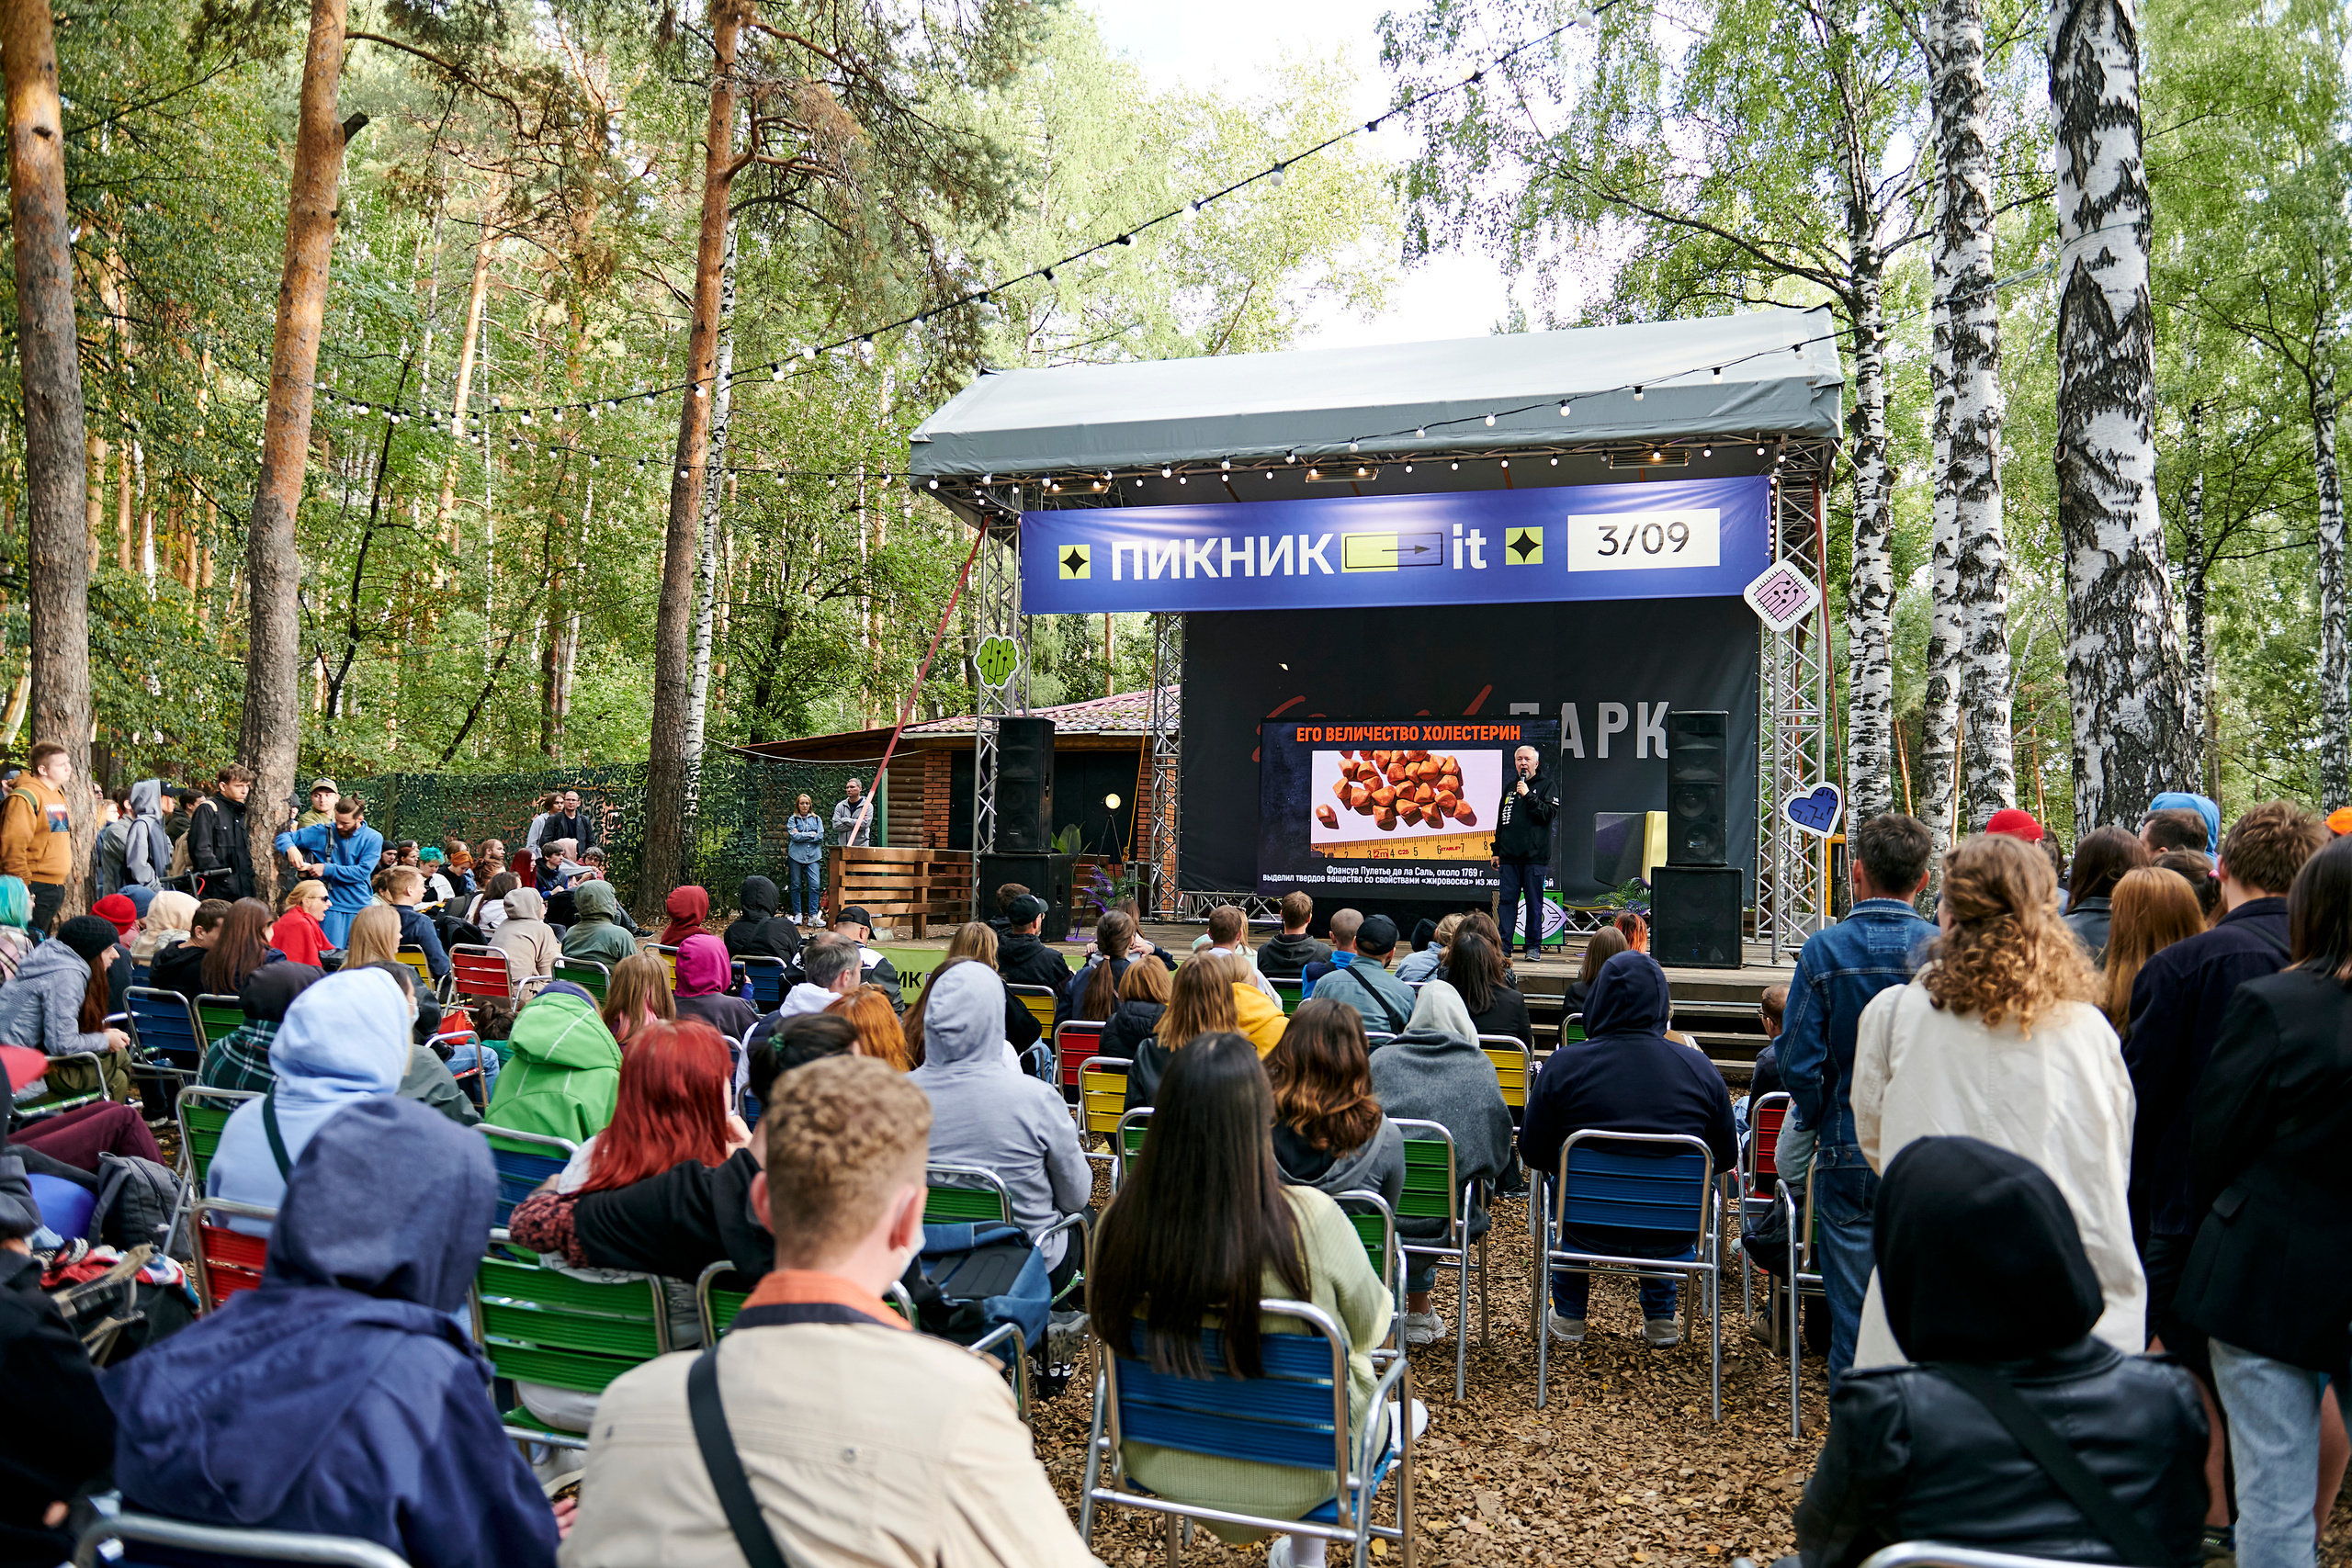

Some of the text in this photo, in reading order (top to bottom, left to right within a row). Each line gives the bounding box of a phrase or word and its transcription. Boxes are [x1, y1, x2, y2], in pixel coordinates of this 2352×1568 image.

[1111, 521, 1690, 581] ПИКНИК it 3/09
[1296, 725, 1521, 742] ЕГО ВЕЛИЧЕСТВО ХОЛЕСТЕРИН
[1510, 701, 1669, 759] АРК
[1367, 850, 1372, 859] 3
[1374, 849, 1388, 859] 2m
[1390, 848, 1395, 858] 4
[1413, 846, 1419, 856] 5
[1437, 844, 1442, 854] 6
[1460, 842, 1464, 853] 7
[1483, 840, 1488, 851] 8
[1326, 864, 1484, 877] Франсуа Пулетье де ла Саль, около 1769 г
[1262, 874, 1295, 883] выделил
[1295, 874, 1326, 884] твердое
[1327, 875, 1363, 884] вещество
[1364, 875, 1374, 884] со
[1374, 874, 1420, 885] свойствами
[1421, 877, 1474, 886] «жировоска»
[1475, 877, 1486, 886] из
